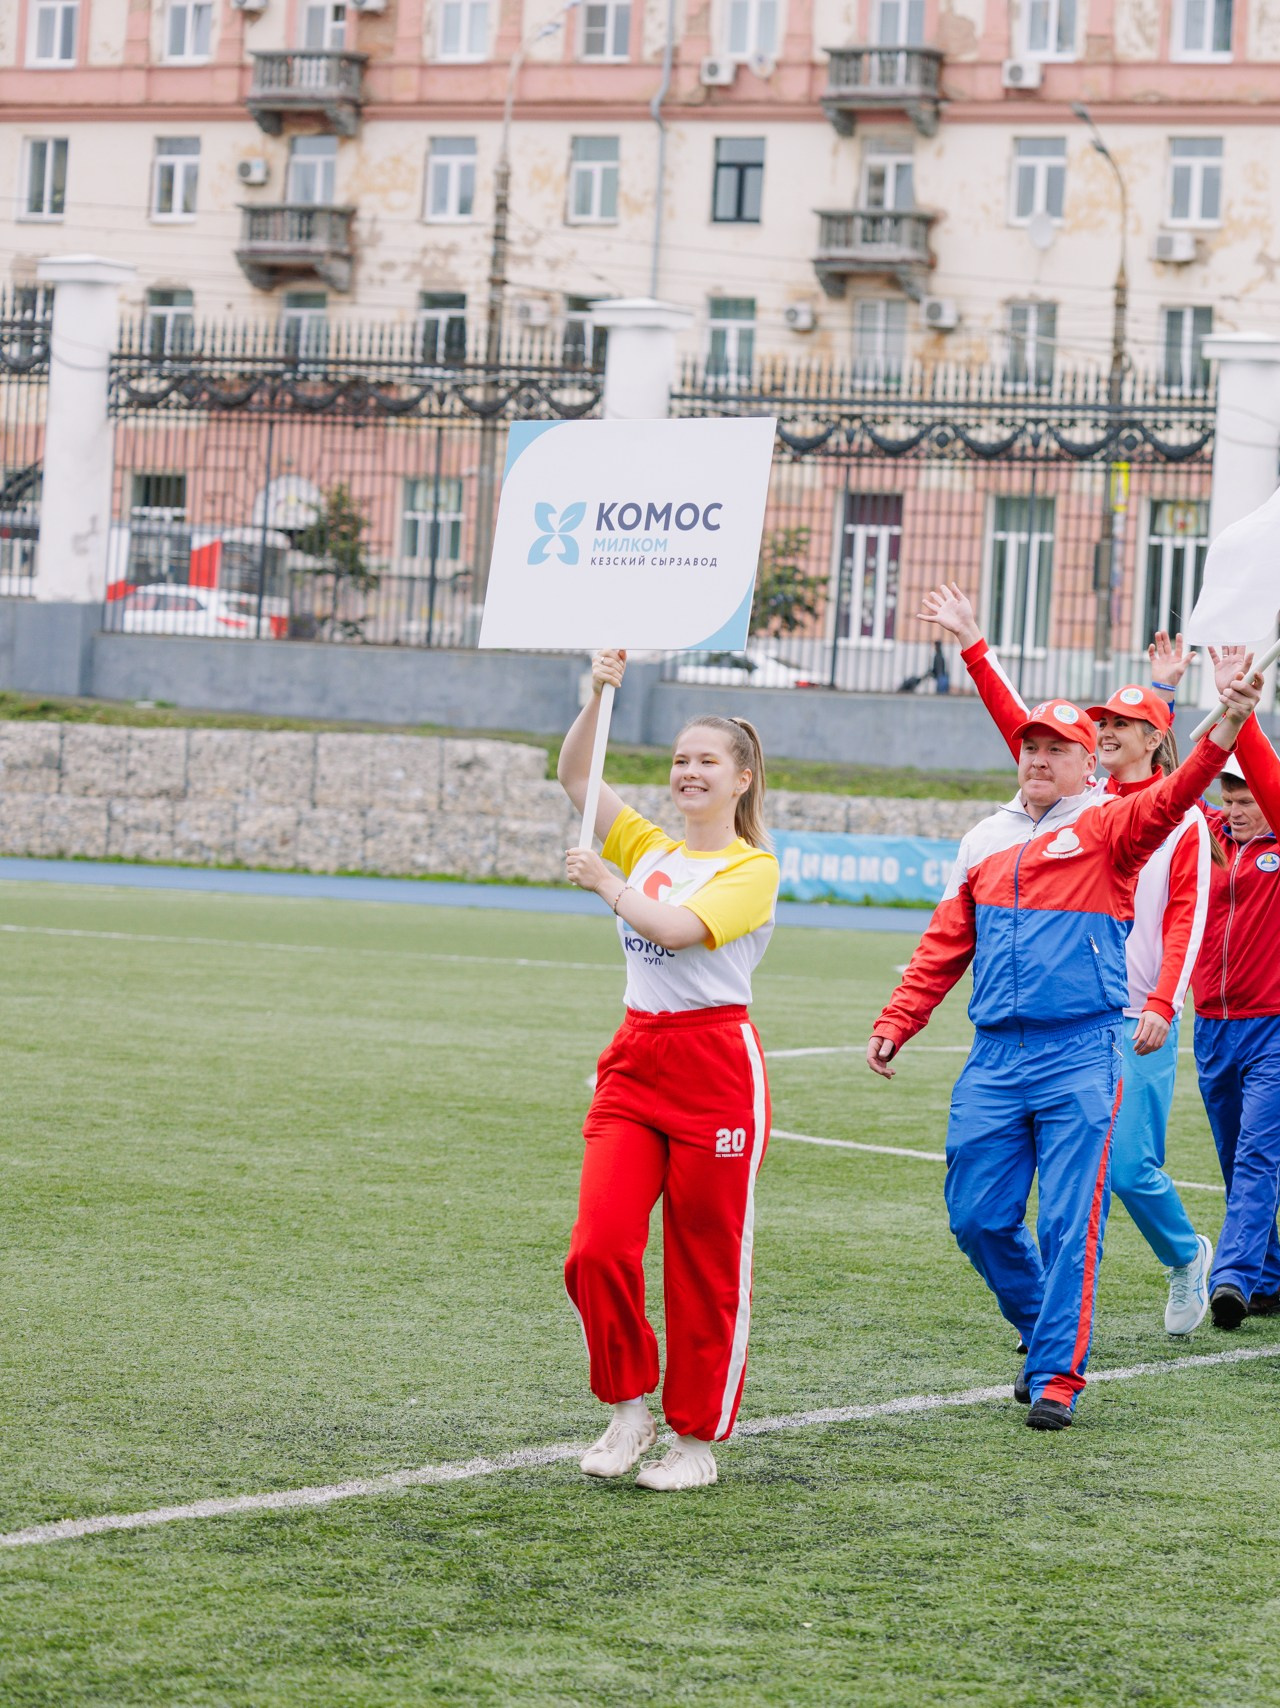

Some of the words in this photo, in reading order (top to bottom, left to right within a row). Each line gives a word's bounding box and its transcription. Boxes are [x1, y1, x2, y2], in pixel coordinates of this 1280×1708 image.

[596, 502, 723, 532] КОМОС
[592, 538, 668, 552] МИЛКОМ
[590, 555, 645, 566] КЕЗСКИЙ
[651, 557, 718, 568] СЫРЗАВОД
[715, 1127, 746, 1153] 20
